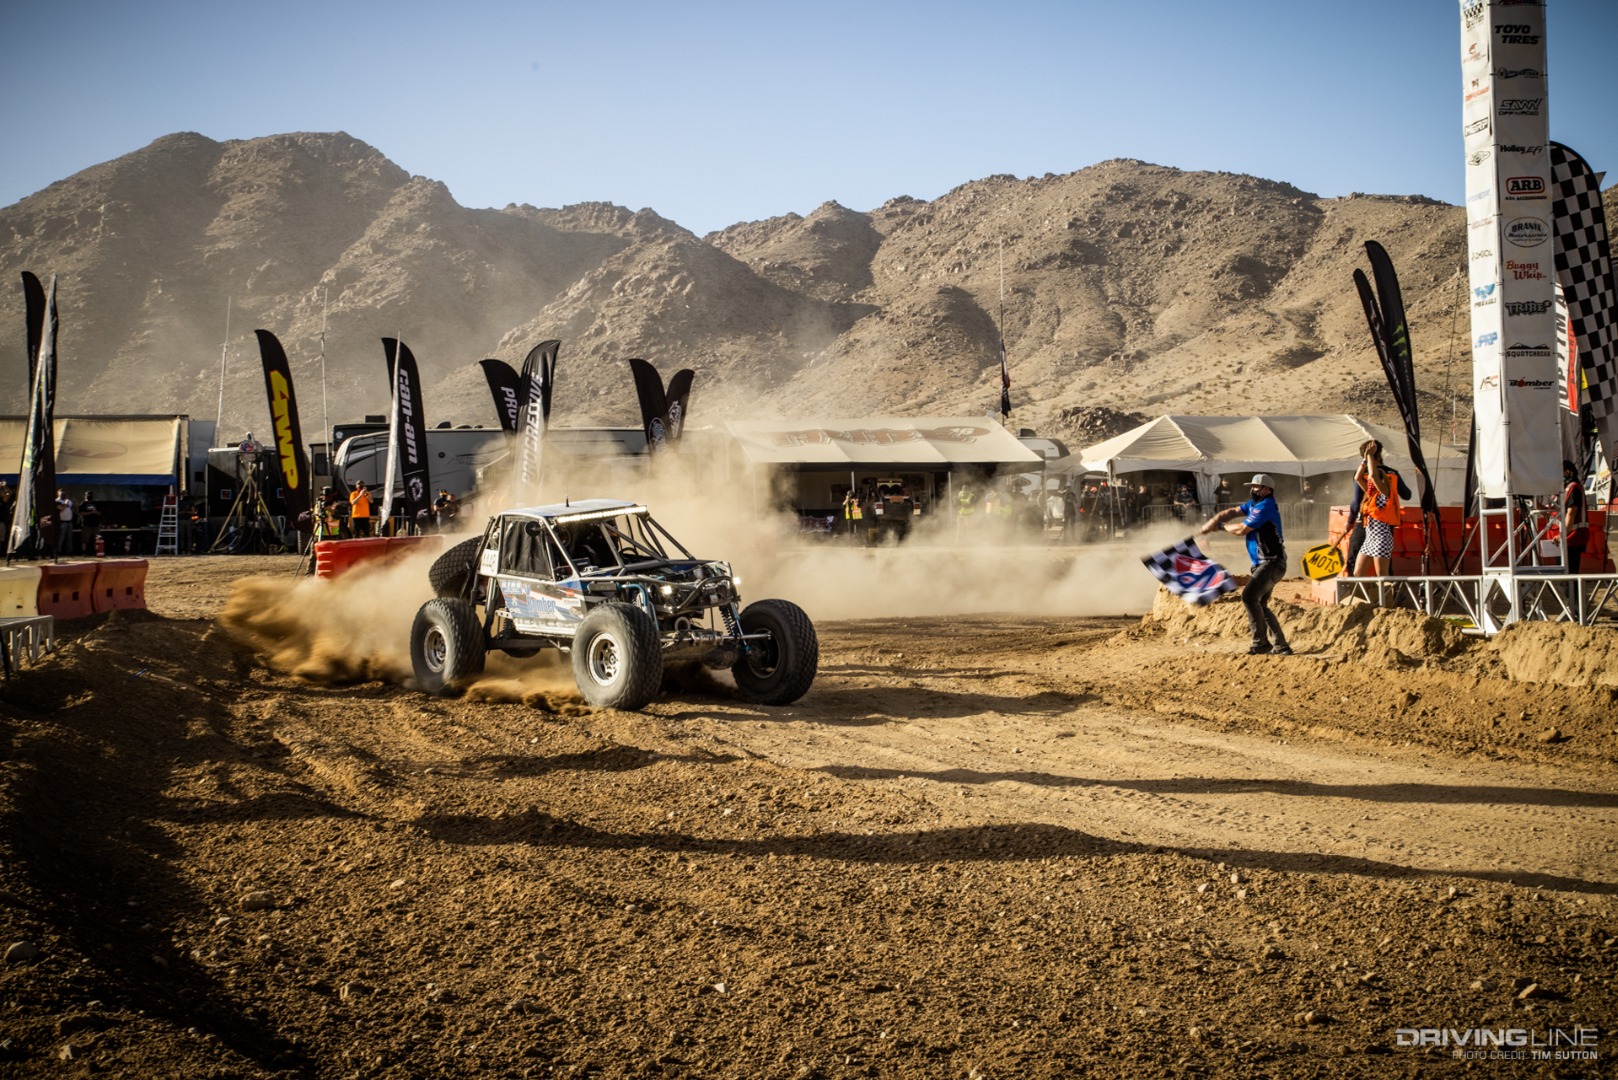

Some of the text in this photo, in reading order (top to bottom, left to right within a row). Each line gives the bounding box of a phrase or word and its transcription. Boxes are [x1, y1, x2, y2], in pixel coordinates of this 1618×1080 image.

[1494, 24, 1531, 34] TOYO
[1501, 34, 1540, 45] TIRES
[1500, 144, 1526, 155] Holley
[1510, 179, 1542, 191] ARB
[1511, 222, 1543, 233] BRANIK
[1506, 261, 1539, 271] Buggy
[1513, 270, 1543, 280] Whip
[1509, 376, 1555, 388] Bomber
[521, 371, 543, 484] PROGRESSIVE
[1308, 553, 1338, 573] SLOW
